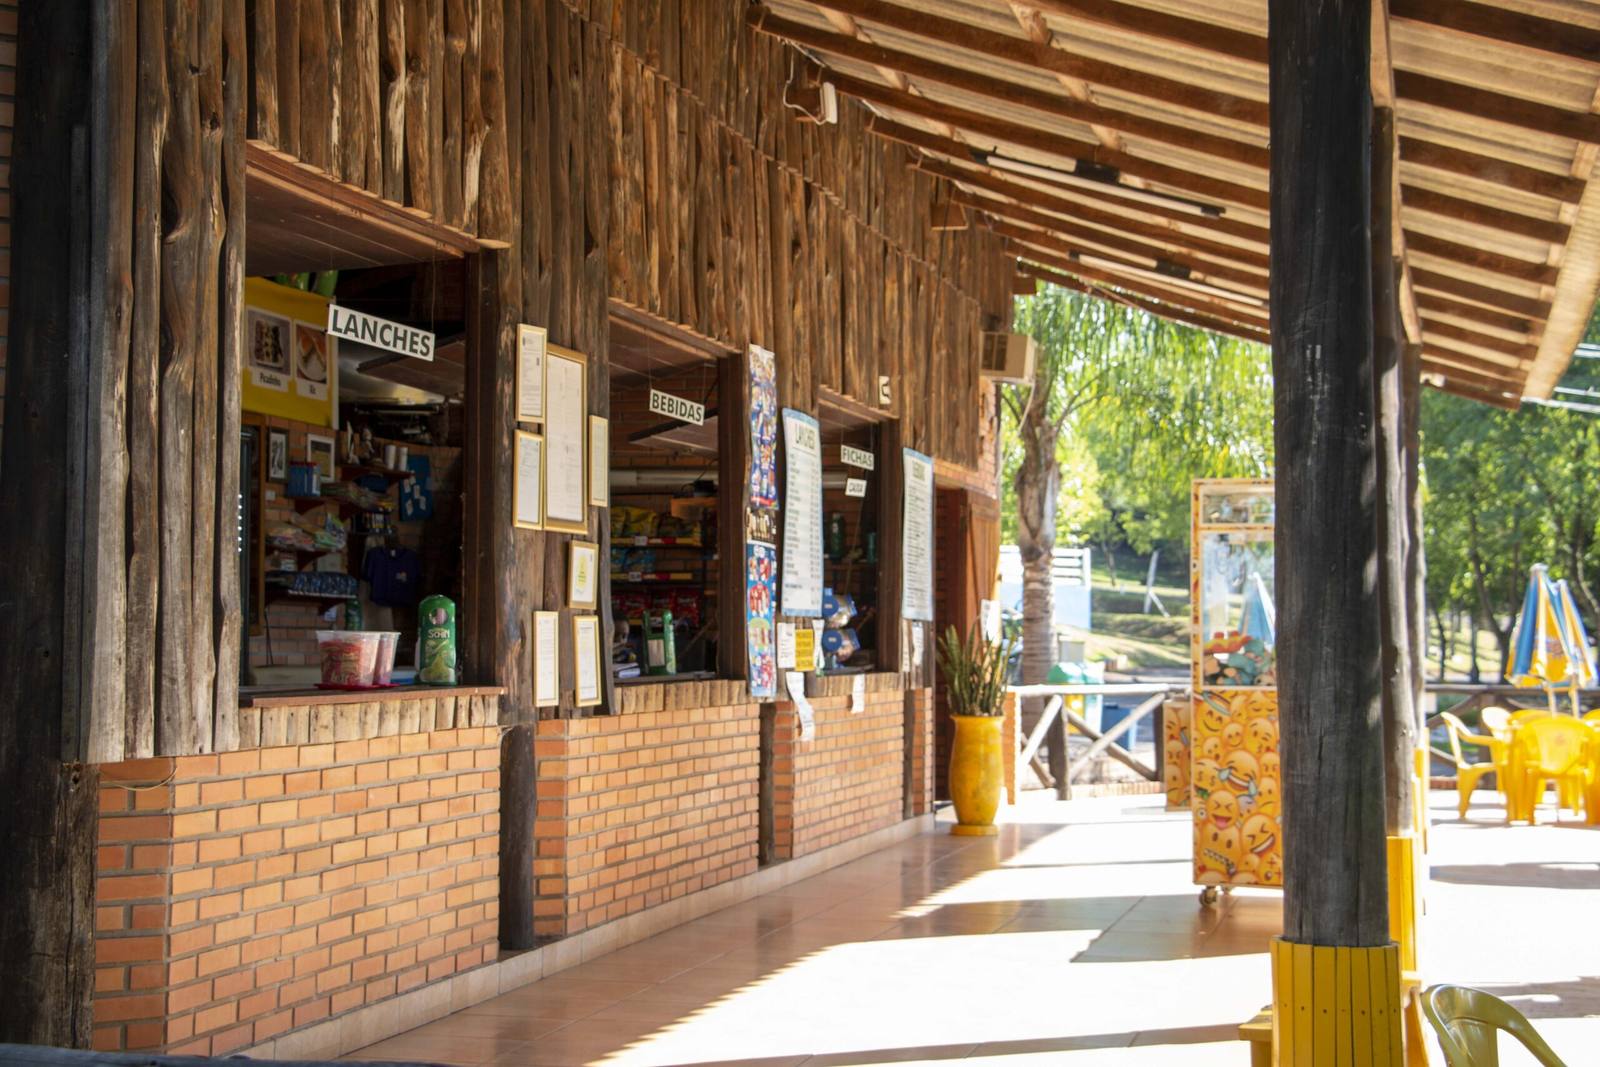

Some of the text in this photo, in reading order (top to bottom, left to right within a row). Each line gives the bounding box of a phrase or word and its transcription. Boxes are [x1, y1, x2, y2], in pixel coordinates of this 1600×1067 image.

[332, 309, 431, 357] LANCHES
[652, 392, 702, 422] BEBIDAS
[842, 447, 873, 467] FICHAS
